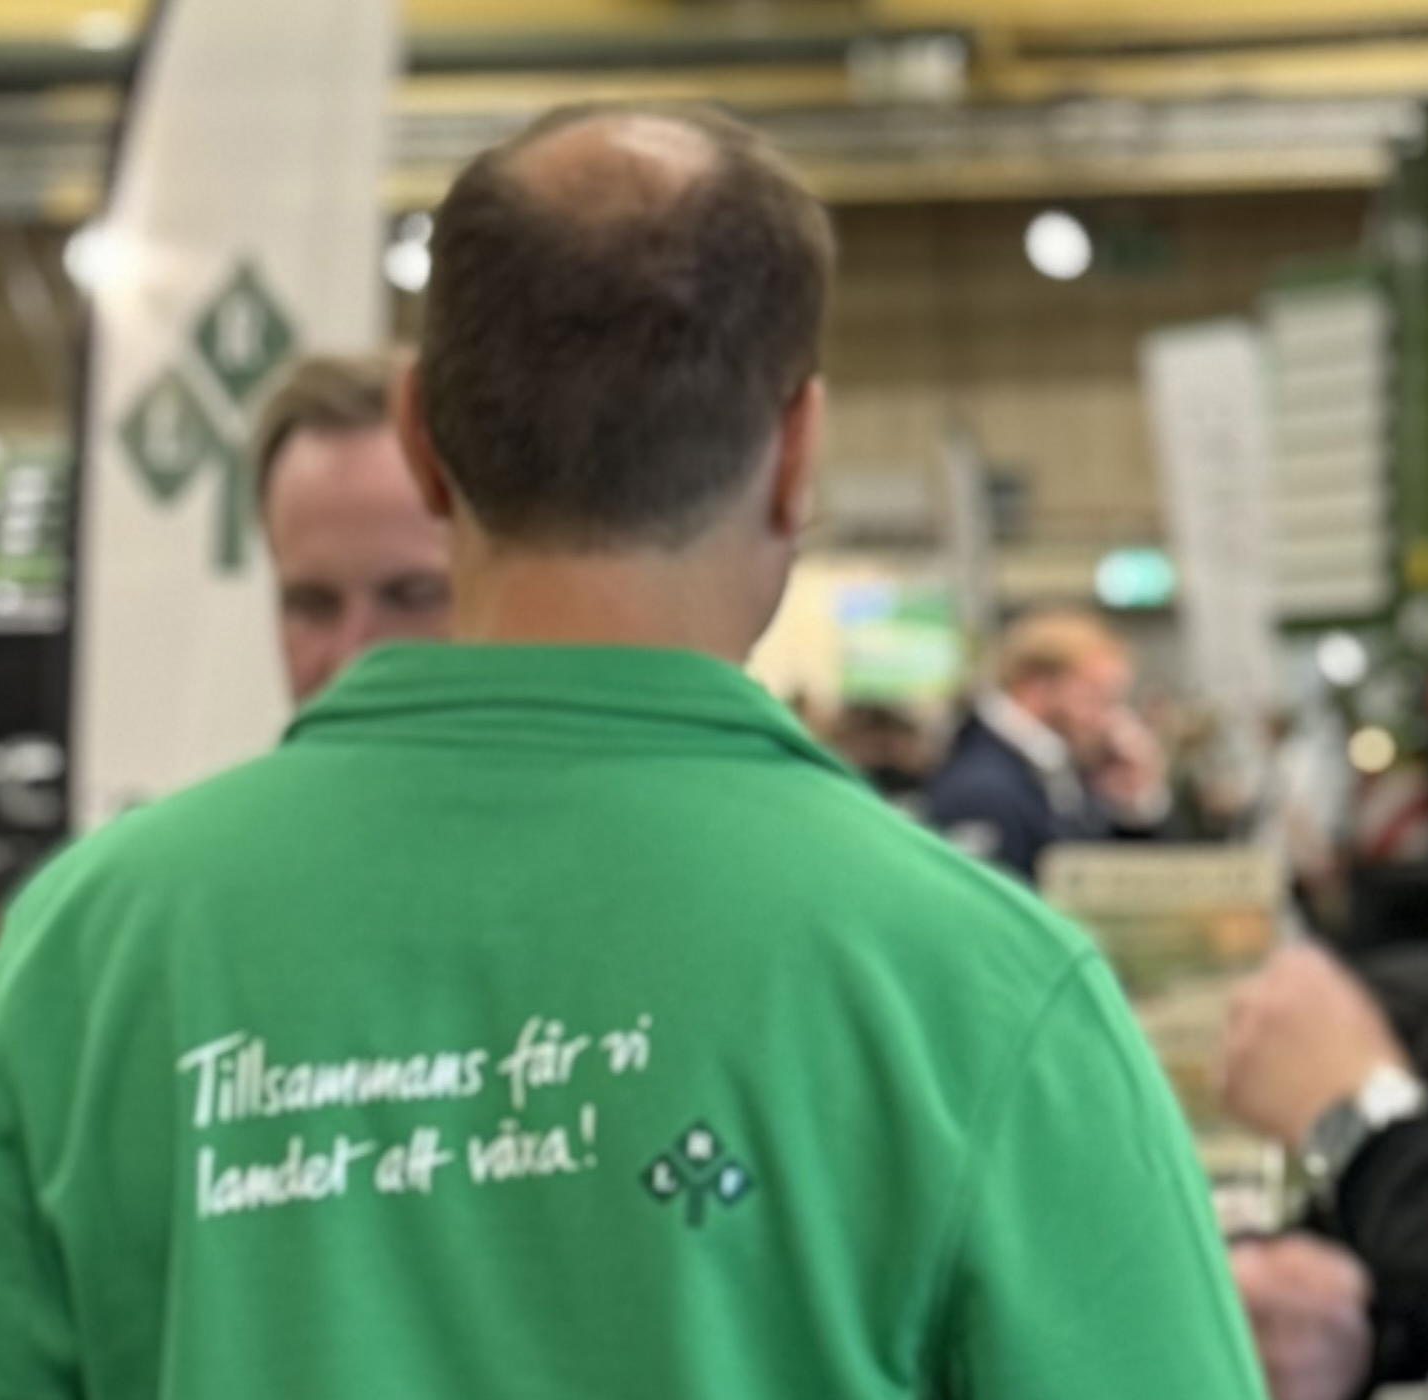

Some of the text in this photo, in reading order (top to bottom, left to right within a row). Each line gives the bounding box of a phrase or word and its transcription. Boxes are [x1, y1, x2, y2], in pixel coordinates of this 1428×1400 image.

[176, 1012, 653, 1128] Tillsammans får vi
[196, 1134, 375, 1220] landet
[375, 1126, 454, 1196] att
